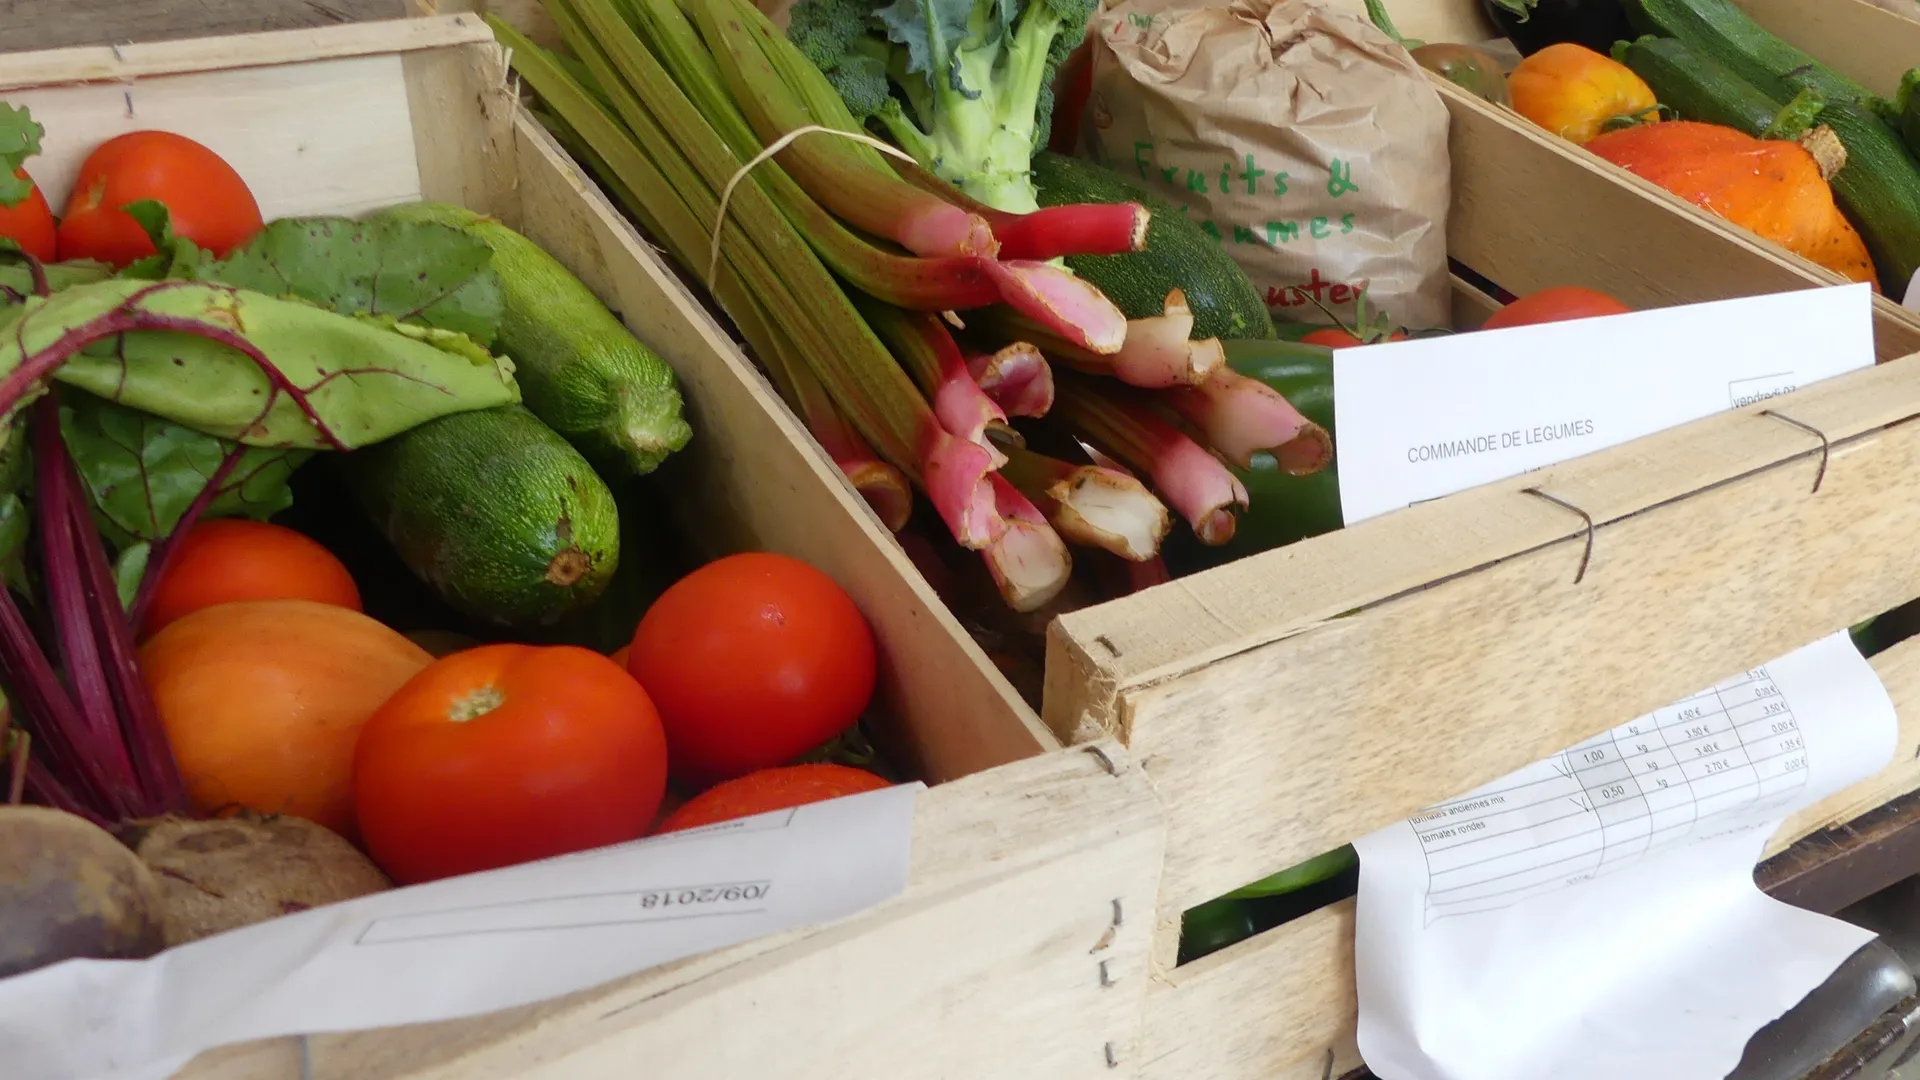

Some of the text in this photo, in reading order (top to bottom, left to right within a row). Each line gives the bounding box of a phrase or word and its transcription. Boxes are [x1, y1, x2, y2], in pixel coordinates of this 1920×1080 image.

[1134, 142, 1360, 198] Fruits &
[1407, 419, 1595, 463] COMMANDE DE LEGUMES
[1628, 726, 1640, 736] kg
[1584, 750, 1605, 764] 1,00
[1636, 744, 1648, 754] kg
[1449, 799, 1490, 816] anciennes
[1491, 795, 1506, 806] mix
[1646, 761, 1659, 771] kg
[1421, 828, 1457, 844] tomates
[1457, 821, 1487, 834] rondes
[1602, 785, 1625, 800] 0,50
[1656, 778, 1669, 789] kg
[641, 884, 770, 909] /09/2018
